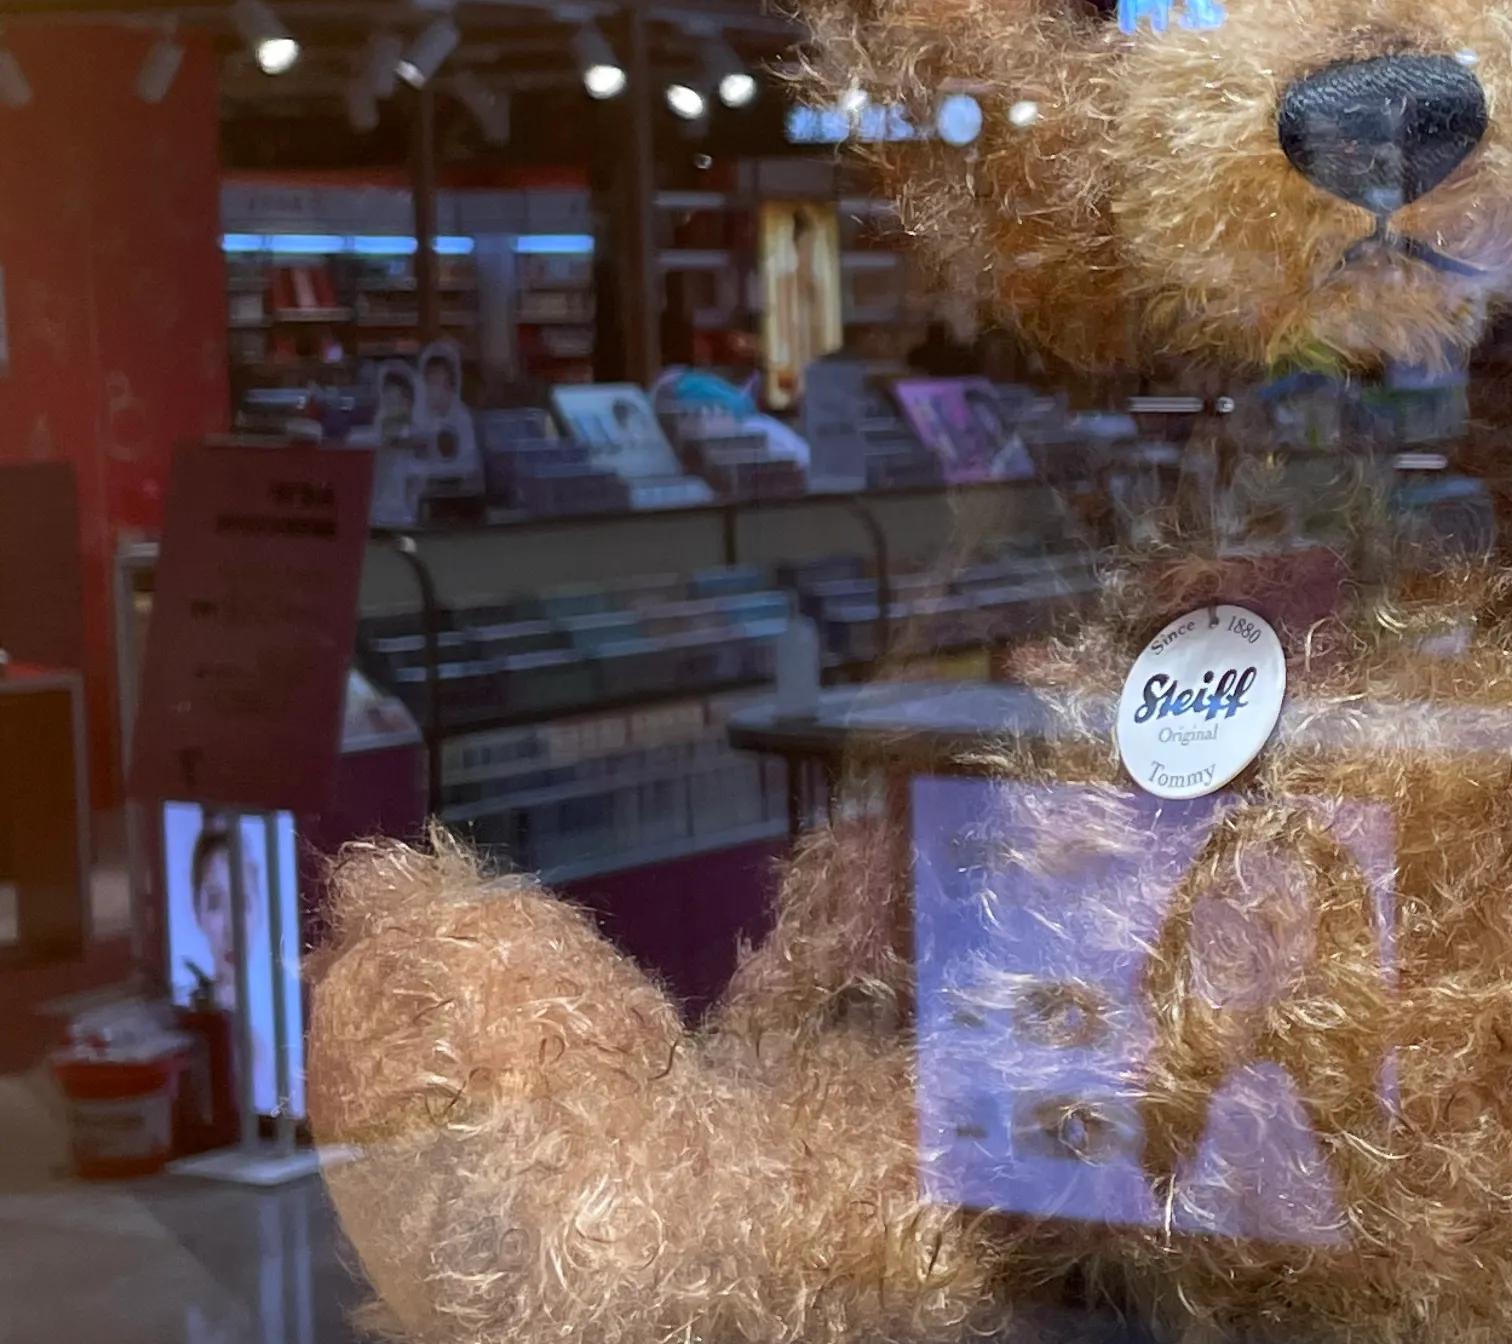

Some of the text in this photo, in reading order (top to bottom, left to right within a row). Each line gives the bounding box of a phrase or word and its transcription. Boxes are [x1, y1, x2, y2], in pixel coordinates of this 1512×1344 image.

[1151, 615, 1263, 655] Since 1880
[1134, 666, 1258, 725] Steiff
[1158, 723, 1219, 746] Original
[1148, 760, 1217, 789] Tommy
